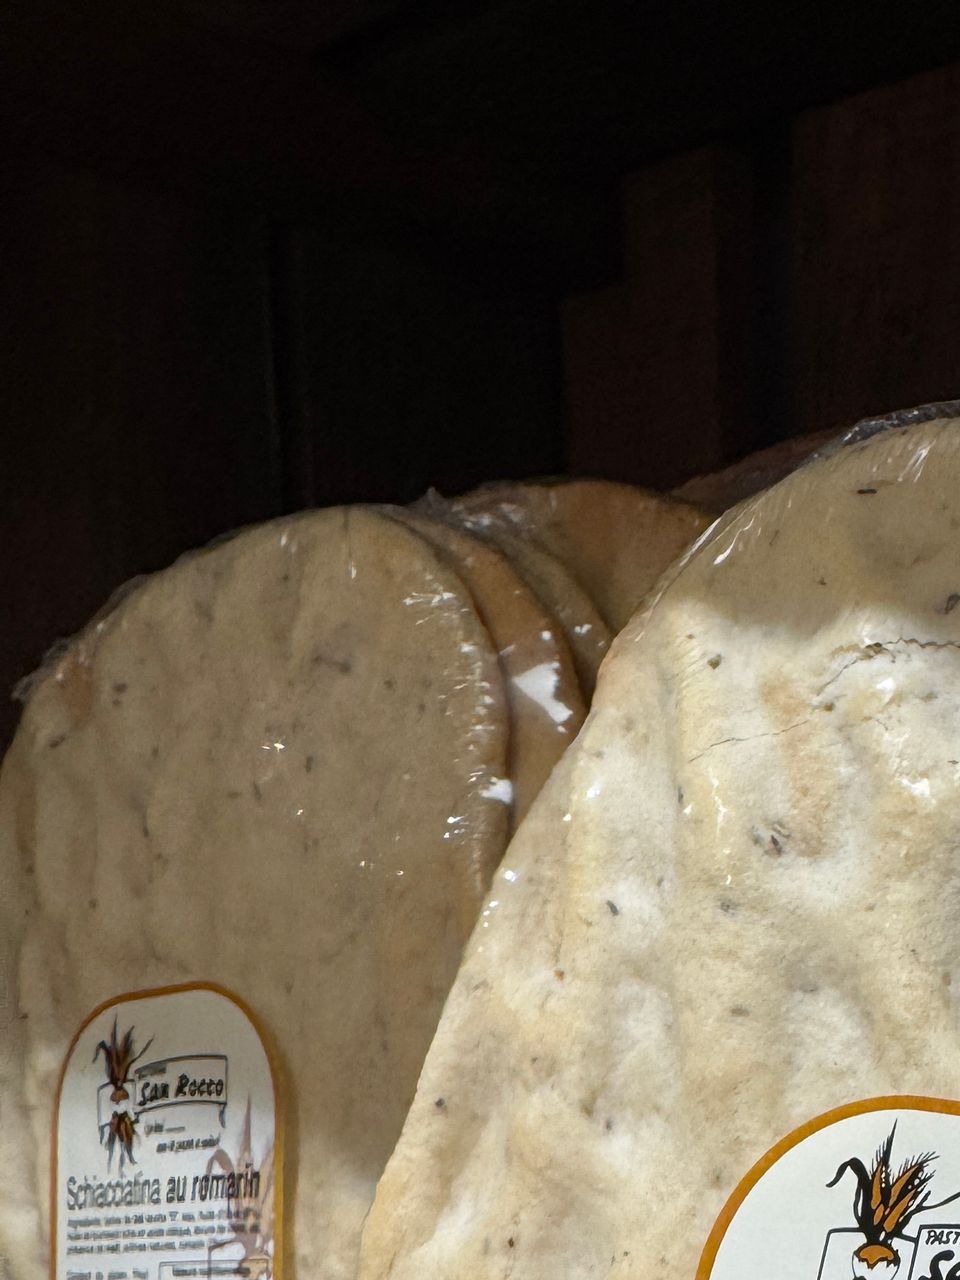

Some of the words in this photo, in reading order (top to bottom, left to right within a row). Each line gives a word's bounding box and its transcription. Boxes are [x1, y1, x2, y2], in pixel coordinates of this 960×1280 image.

[138, 1081, 169, 1106] San
[166, 1176, 187, 1203] au
[191, 1162, 261, 1201] romarin
